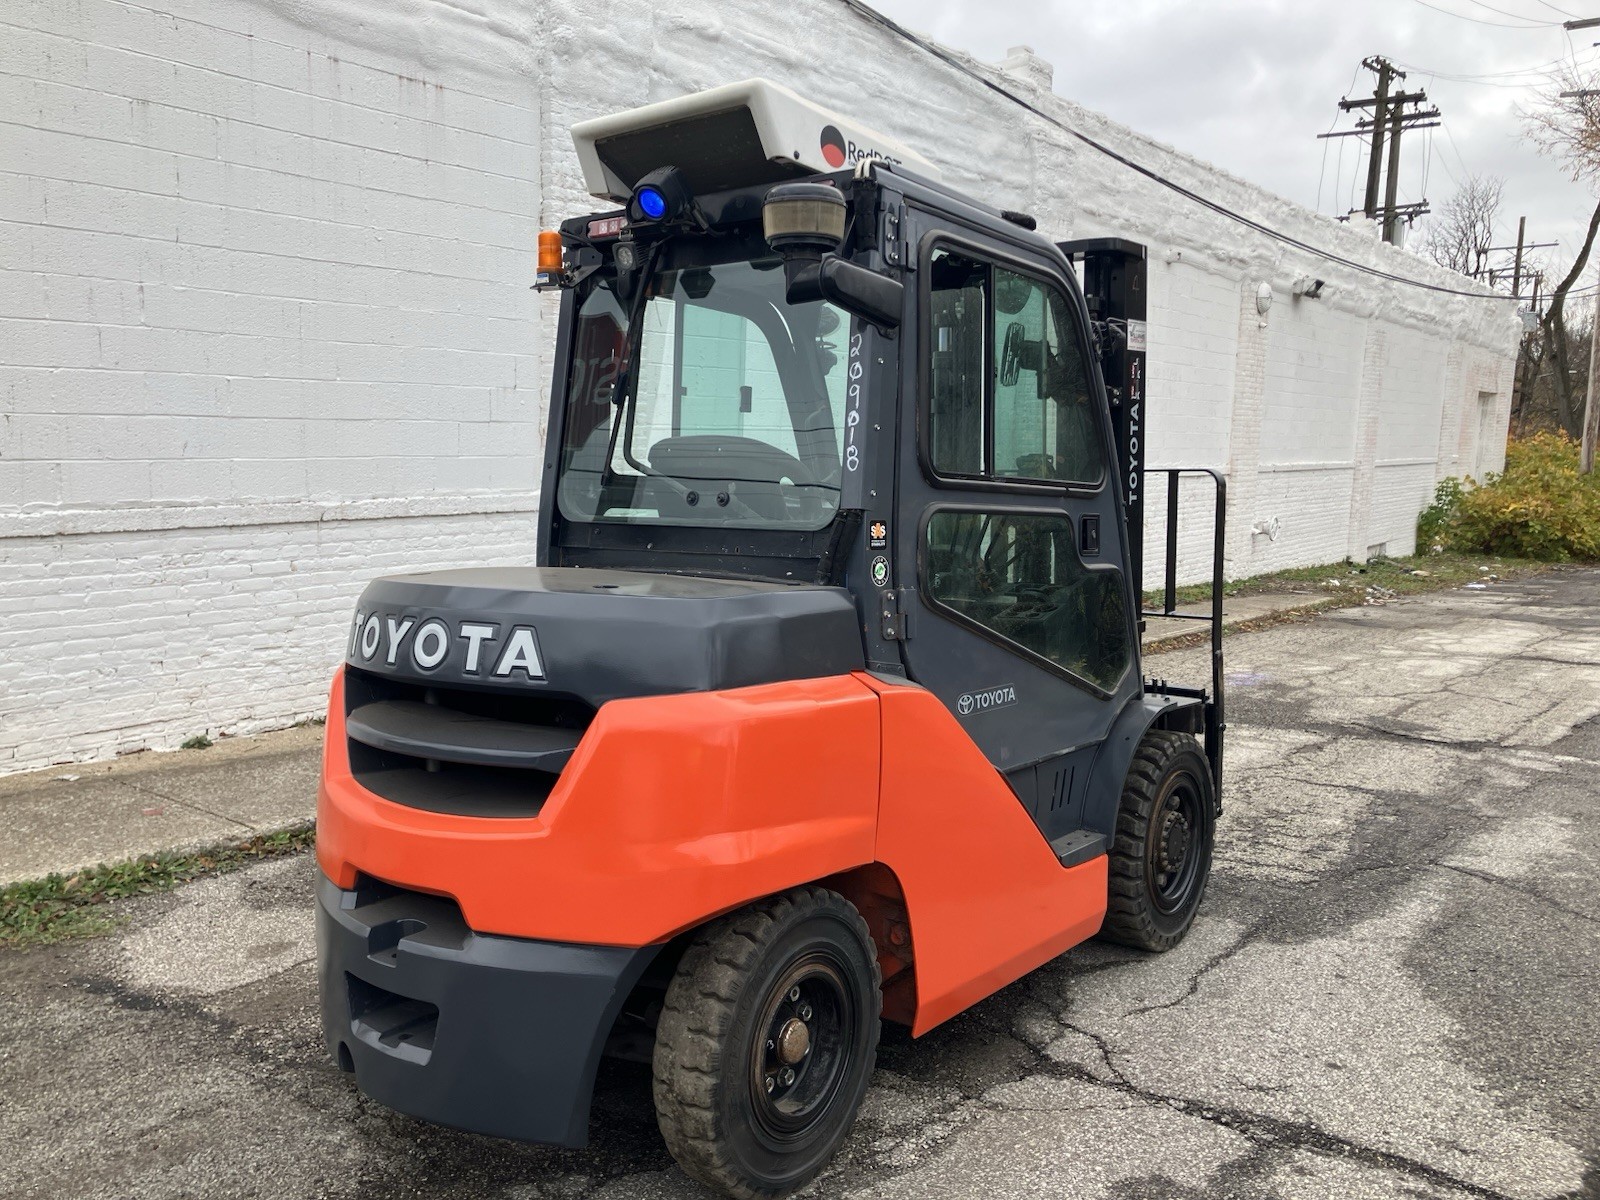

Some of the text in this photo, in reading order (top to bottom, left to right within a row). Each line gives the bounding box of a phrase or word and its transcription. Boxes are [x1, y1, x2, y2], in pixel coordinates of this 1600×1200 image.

[1129, 403, 1139, 506] TOYOTA
[870, 522, 886, 539] SAS
[350, 612, 544, 677] TOYOTA
[975, 687, 1016, 709] TOYOTA
